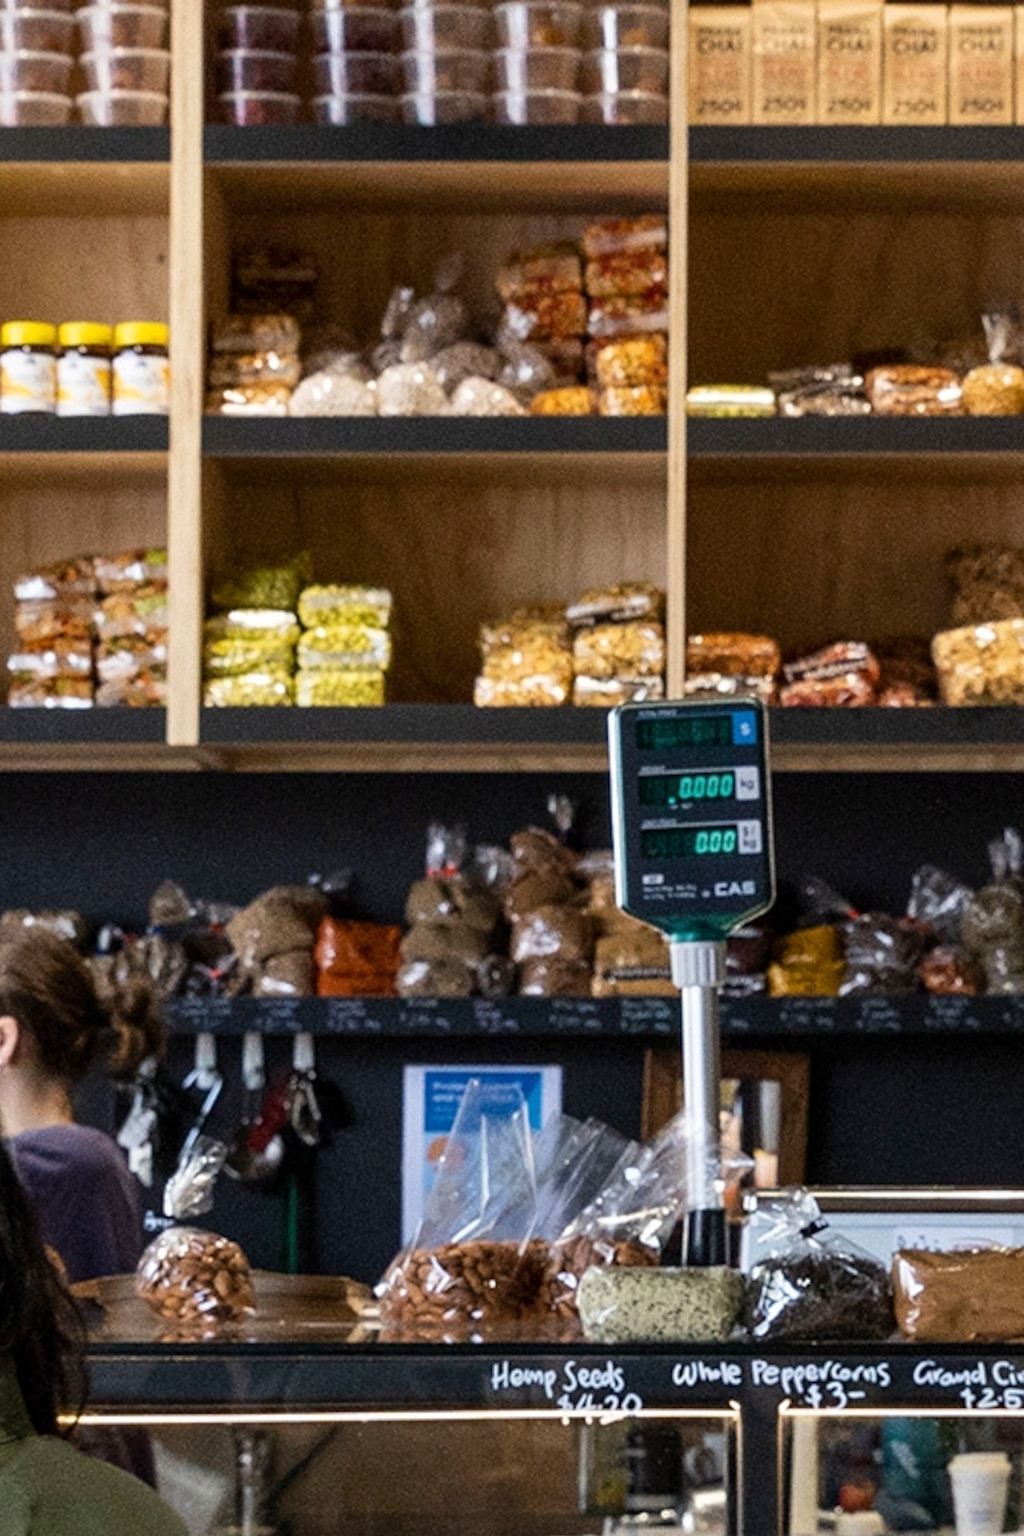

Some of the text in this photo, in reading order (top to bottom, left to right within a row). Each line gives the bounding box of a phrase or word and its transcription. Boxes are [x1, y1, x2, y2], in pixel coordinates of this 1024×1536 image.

[714, 881, 756, 897] CAS
[491, 1360, 625, 1398] Hemp Seeds
[672, 1359, 891, 1394] Whole Peppercorns
